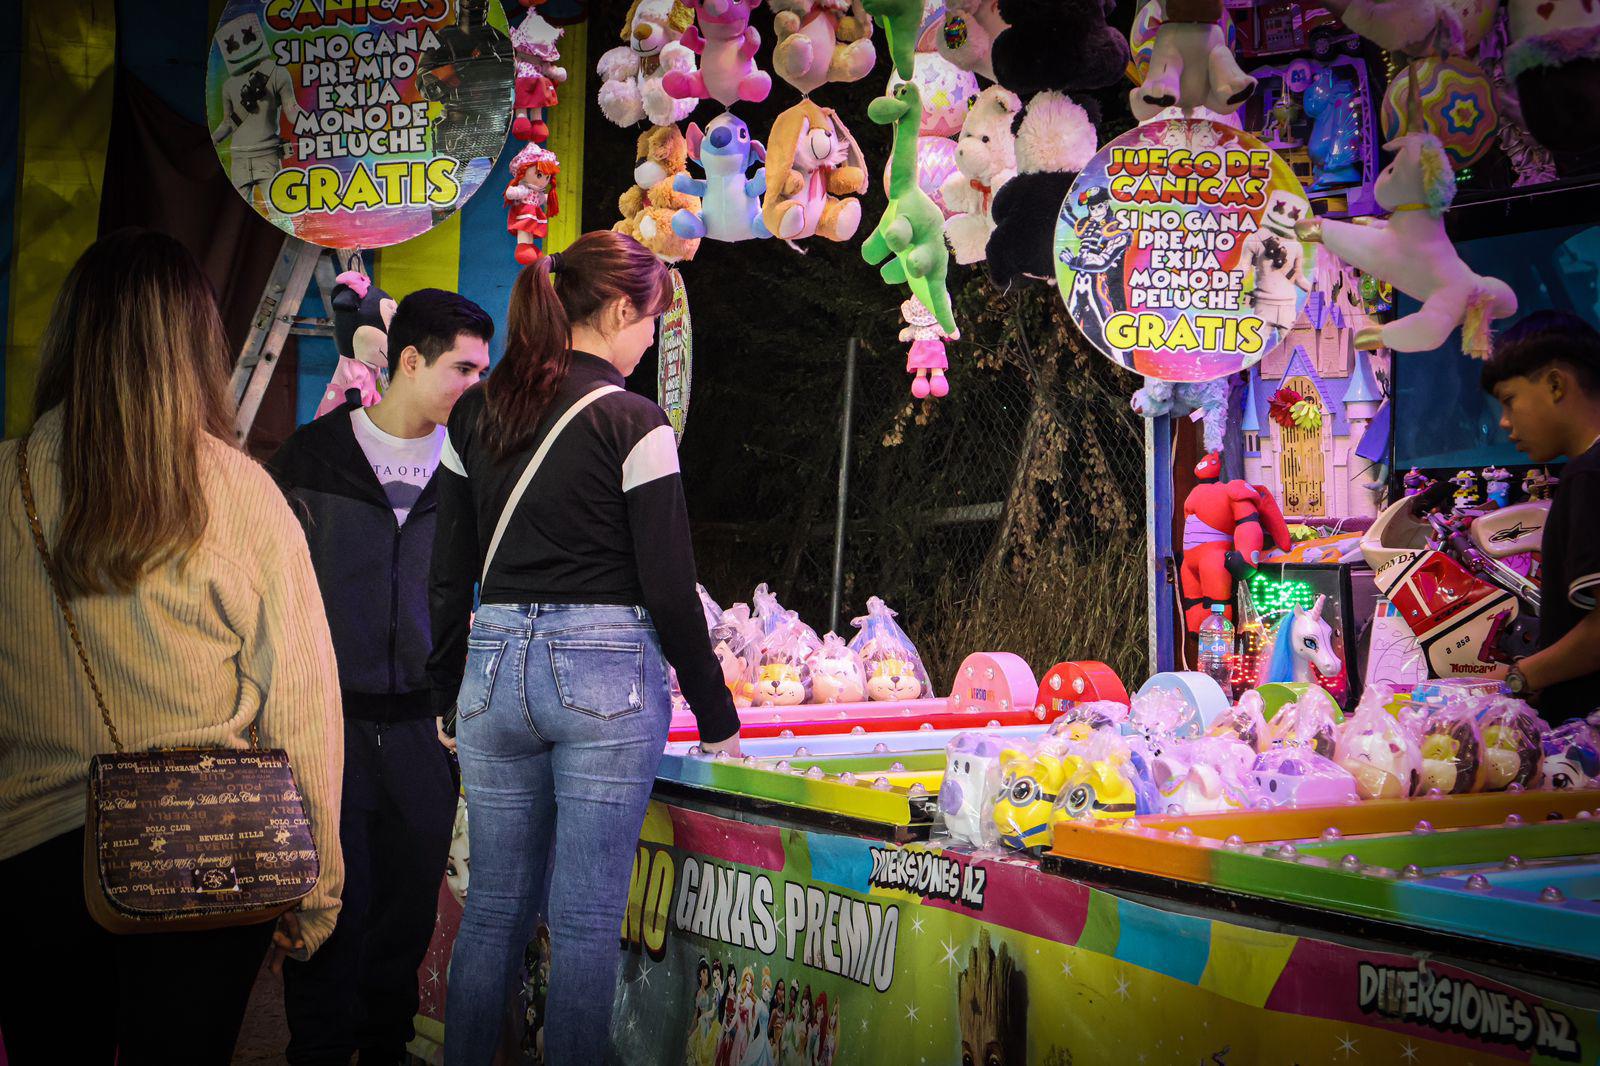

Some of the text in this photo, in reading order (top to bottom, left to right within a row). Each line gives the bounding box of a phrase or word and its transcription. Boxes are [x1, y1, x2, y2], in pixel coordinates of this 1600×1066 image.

[275, 26, 442, 66] SI NO GANA
[302, 54, 416, 87] PREMIO
[319, 80, 400, 110] EXIJA
[293, 102, 429, 135] MONO DE
[299, 128, 426, 161] PELUCHE
[1107, 148, 1271, 179] JUEGO DE
[268, 158, 460, 214] GRATIS
[1109, 176, 1267, 207] CANICAS
[1116, 210, 1258, 233] SI NO GANA
[1138, 230, 1236, 252] PREMIO
[1150, 250, 1221, 270] EXIJA
[1128, 269, 1244, 291] MONO DE
[1132, 288, 1239, 310] PELUCHE
[1104, 314, 1264, 353] GRATIS
[869, 847, 986, 910] DIVERSIONES AZ
[621, 848, 899, 992] NO GANAS PREMIO
[1535, 1004, 1581, 1062] AZ
